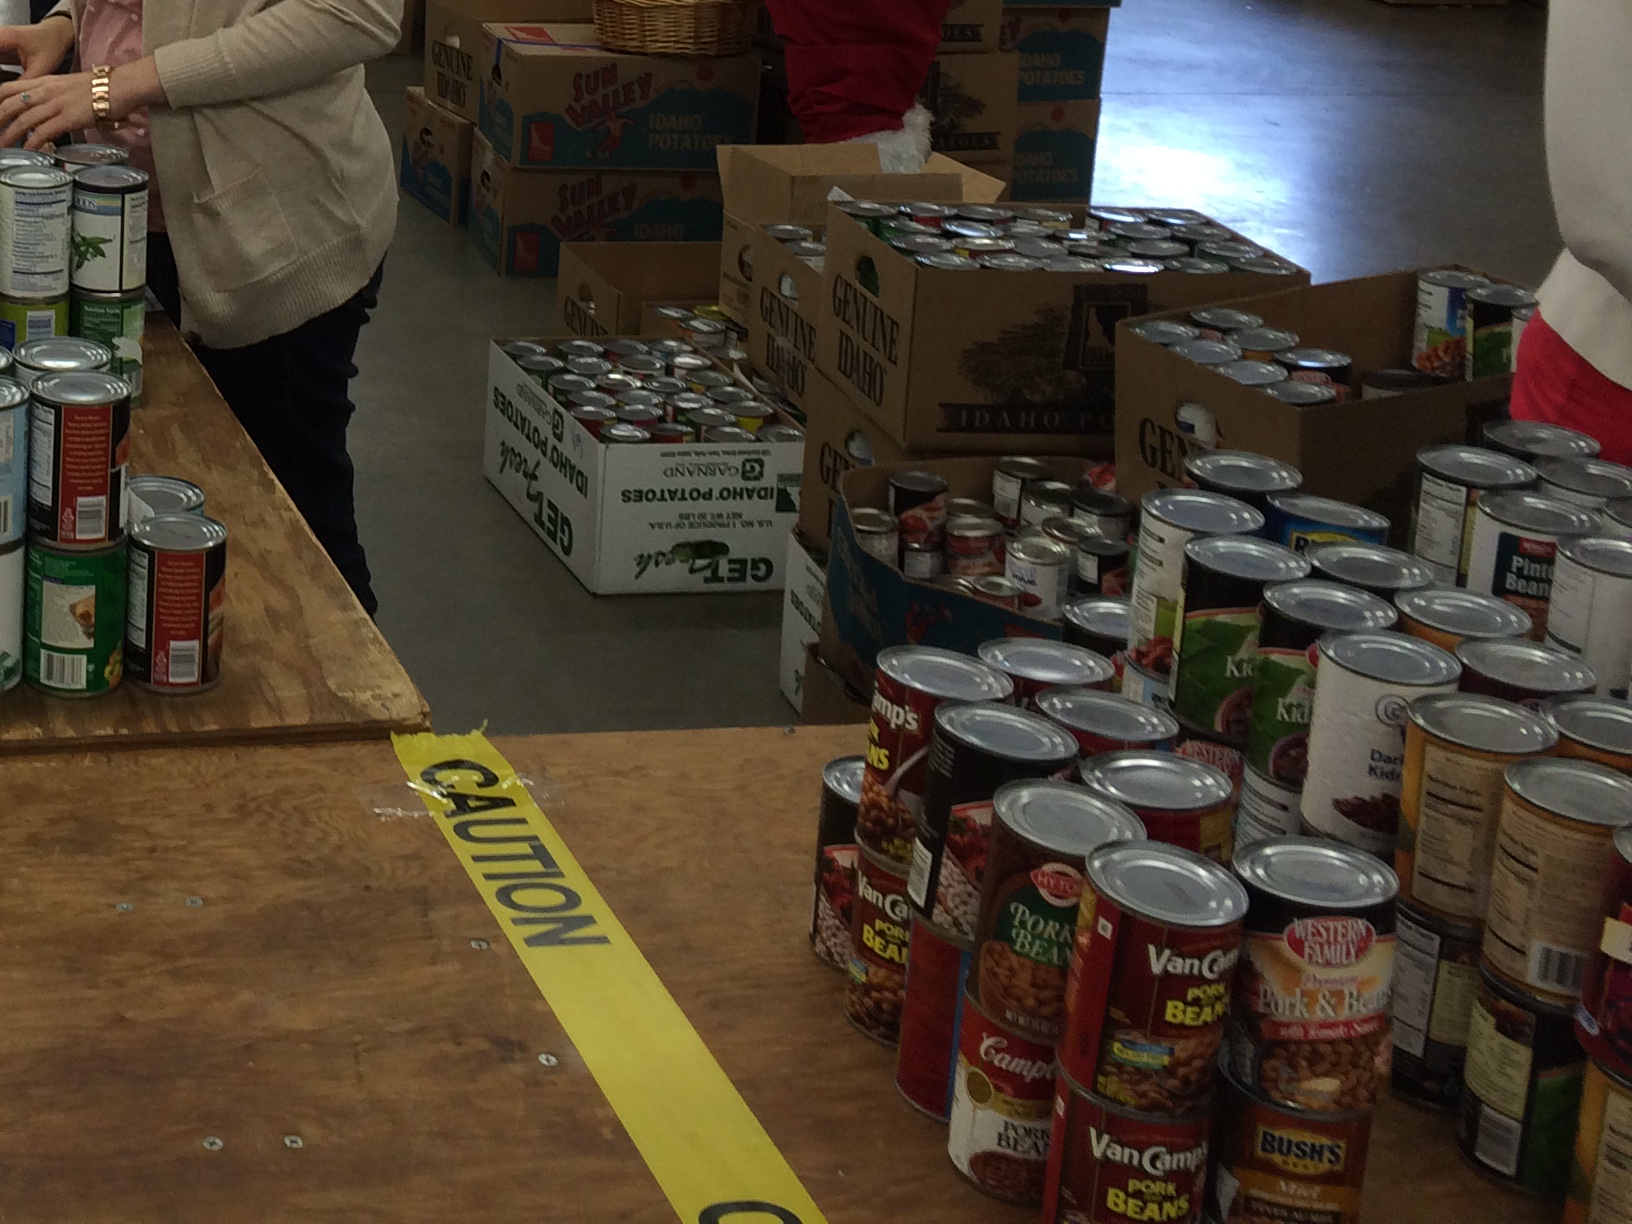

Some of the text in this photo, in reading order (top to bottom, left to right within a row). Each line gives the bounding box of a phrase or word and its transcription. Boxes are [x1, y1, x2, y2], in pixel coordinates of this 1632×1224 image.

[432, 39, 474, 82] GENUINE
[436, 71, 467, 108] IDAHO
[565, 73, 654, 127] VALLEY
[573, 63, 618, 103] SUN
[649, 113, 699, 130] IDAHO
[559, 175, 603, 214] SUN
[760, 285, 817, 364] GENUINE
[832, 273, 900, 367] GENUINE
[766, 331, 806, 398] IDAHO
[837, 329, 885, 408] IDAHO
[960, 409, 1060, 427] IDAHO
[492, 384, 589, 501] IDAHO POTATOES
[663, 465, 740, 478] GARNAND
[620, 486, 775, 504] IDAHO POTATOES
[533, 497, 574, 558] GET
[704, 557, 774, 584] GET
[1505, 572, 1552, 594] Bean
[1277, 696, 1312, 722] Kid
[419, 758, 613, 950] CAUTION
[1293, 916, 1368, 944] WESTERN
[1302, 941, 1358, 966] FAMILY
[1259, 982, 1308, 1018] Pork
[1316, 987, 1339, 1018] &
[1260, 1129, 1343, 1166] BUSH'S
[1106, 1186, 1190, 1223] BEANS
[1126, 1177, 1177, 1197] PORK
